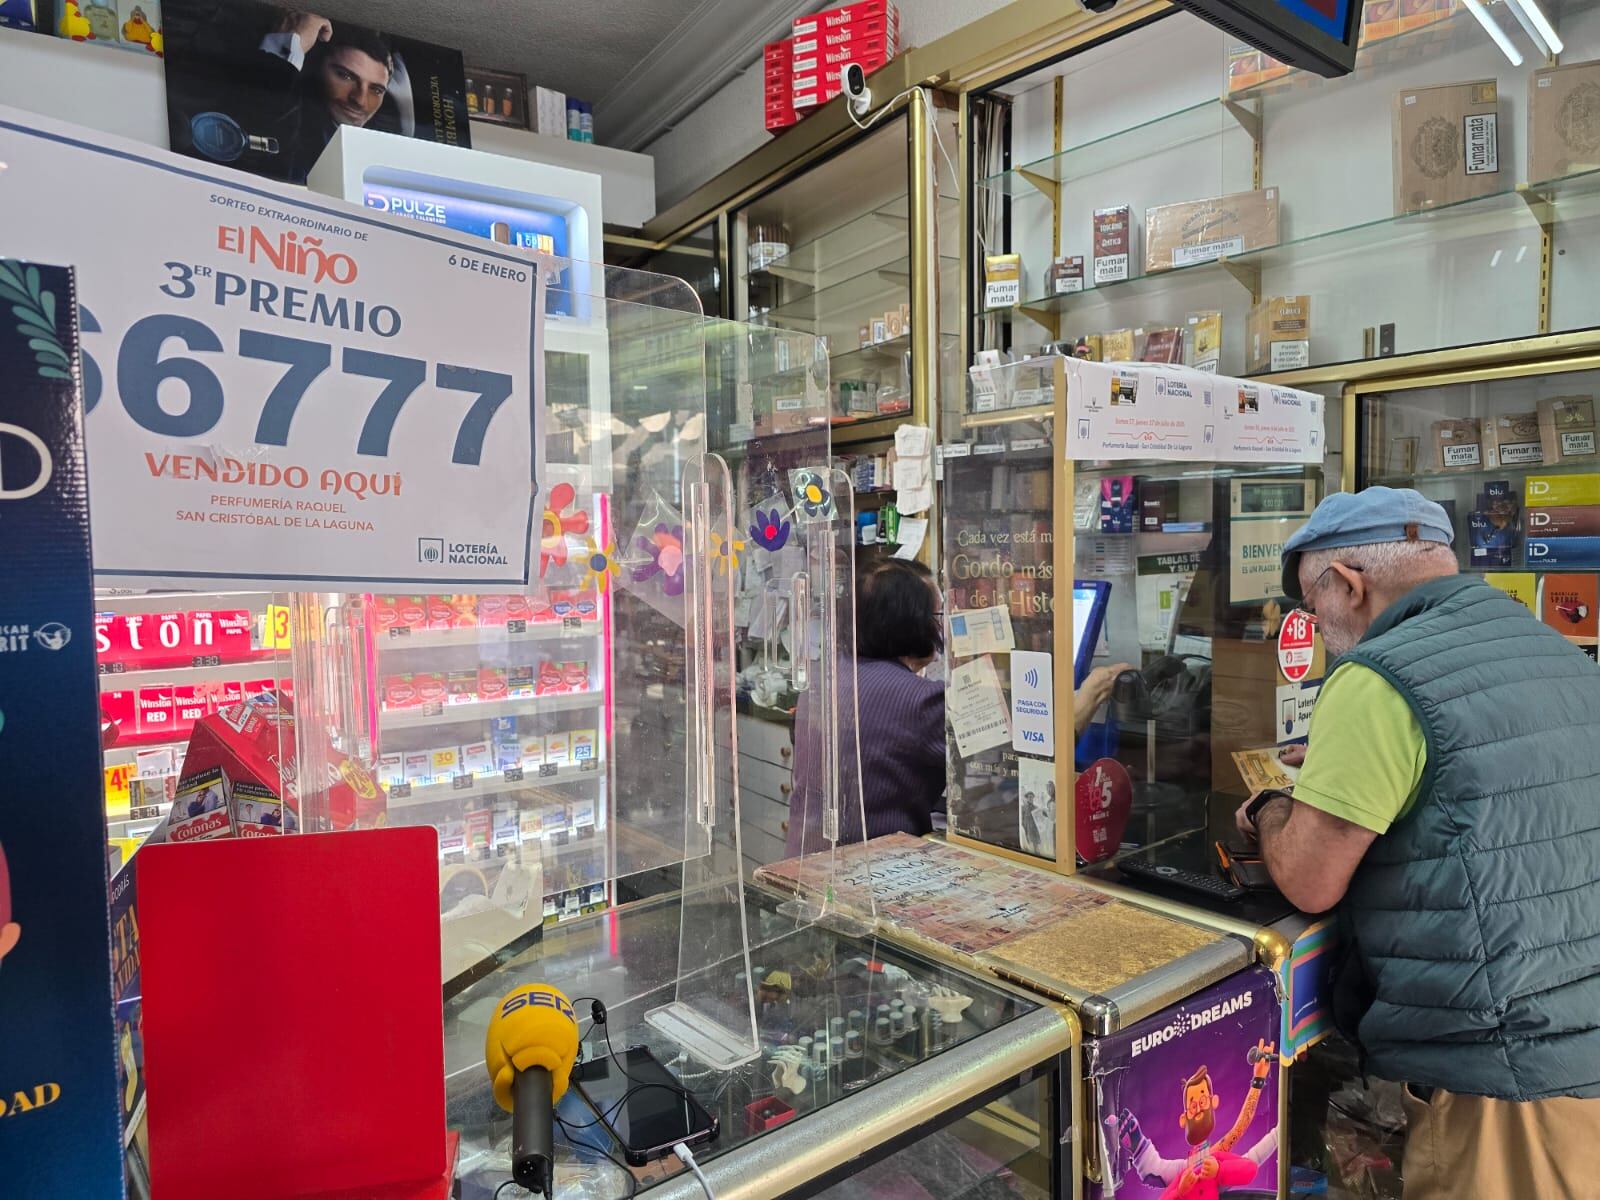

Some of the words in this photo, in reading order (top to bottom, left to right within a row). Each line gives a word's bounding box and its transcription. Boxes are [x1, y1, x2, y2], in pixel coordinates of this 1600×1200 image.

[826, 14, 851, 27] Winston
[826, 32, 851, 45] Winston
[826, 50, 851, 63] Winston
[826, 71, 842, 82] Wins
[1471, 117, 1484, 141] mata
[1469, 142, 1485, 172] Fumar
[391, 197, 447, 219] PULZE
[209, 194, 256, 213] SORTEO
[257, 206, 352, 237] EXTRAORDINARIO
[354, 231, 369, 241] DE
[1100, 222, 1123, 232] TOSCANO
[217, 224, 245, 254] El
[249, 224, 358, 285] Niño
[1183, 245, 1210, 256] Fumar
[1212, 242, 1234, 251] mata
[1096, 256, 1127, 267] Fumar
[448, 254, 457, 266] 6
[460, 257, 479, 271] DE
[482, 263, 528, 283] ENERO
[1100, 266, 1123, 274] mata
[987, 284, 1018, 294] Fumar
[214, 271, 402, 338] PREMIO
[991, 295, 1014, 304] mata
[78, 304, 513, 466] 6777
[1167, 379, 1188, 389] LOTERÍA
[1167, 388, 1193, 398] NACIONAL
[1565, 434, 1591, 443] Fumar
[1569, 441, 1589, 449] mata
[1447, 446, 1475, 455] Fumar
[1501, 447, 1530, 455] Fumar
[144, 452, 309, 489] VENDIDO
[320, 469, 401, 500] AQUÍ
[1529, 481, 1549, 494] iD
[211, 494, 293, 511] PERFUMERÍA
[296, 500, 346, 513] RAQUEL
[176, 510, 205, 522] SAN
[209, 511, 281, 526] CRISTÓBAL
[284, 517, 302, 527] DE
[305, 518, 321, 529] LA
[323, 519, 374, 531] LAGUNA
[1530, 512, 1550, 526] iD
[957, 530, 986, 547] Cada
[990, 533, 1009, 544] vez
[1013, 530, 1036, 544] está
[449, 543, 498, 554] LOTERÍA
[1529, 543, 1549, 556] iD
[448, 554, 508, 565] NACIONAL
[1157, 554, 1188, 565] TABLAS
[952, 553, 1013, 580] Gordo
[1021, 560, 1052, 579] más
[969, 591, 988, 608] de
[218, 619, 249, 628] Winston
[1286, 618, 1307, 641] +18
[140, 699, 172, 710] Winston
[175, 696, 207, 707] Winston
[1017, 699, 1033, 708] PAGA
[146, 712, 167, 722] RED
[182, 708, 202, 720] RED
[1016, 706, 1049, 716] SEGURIDAD
[1022, 729, 1045, 743] VISA
[436, 752, 453, 763] 30
[576, 746, 590, 757] 25
[1101, 780, 1113, 809] 5
[843, 869, 885, 887] 250
[501, 991, 576, 1025] SER
[1131, 1024, 1176, 1058] EURO
[1190, 990, 1253, 1031] DREAMS
